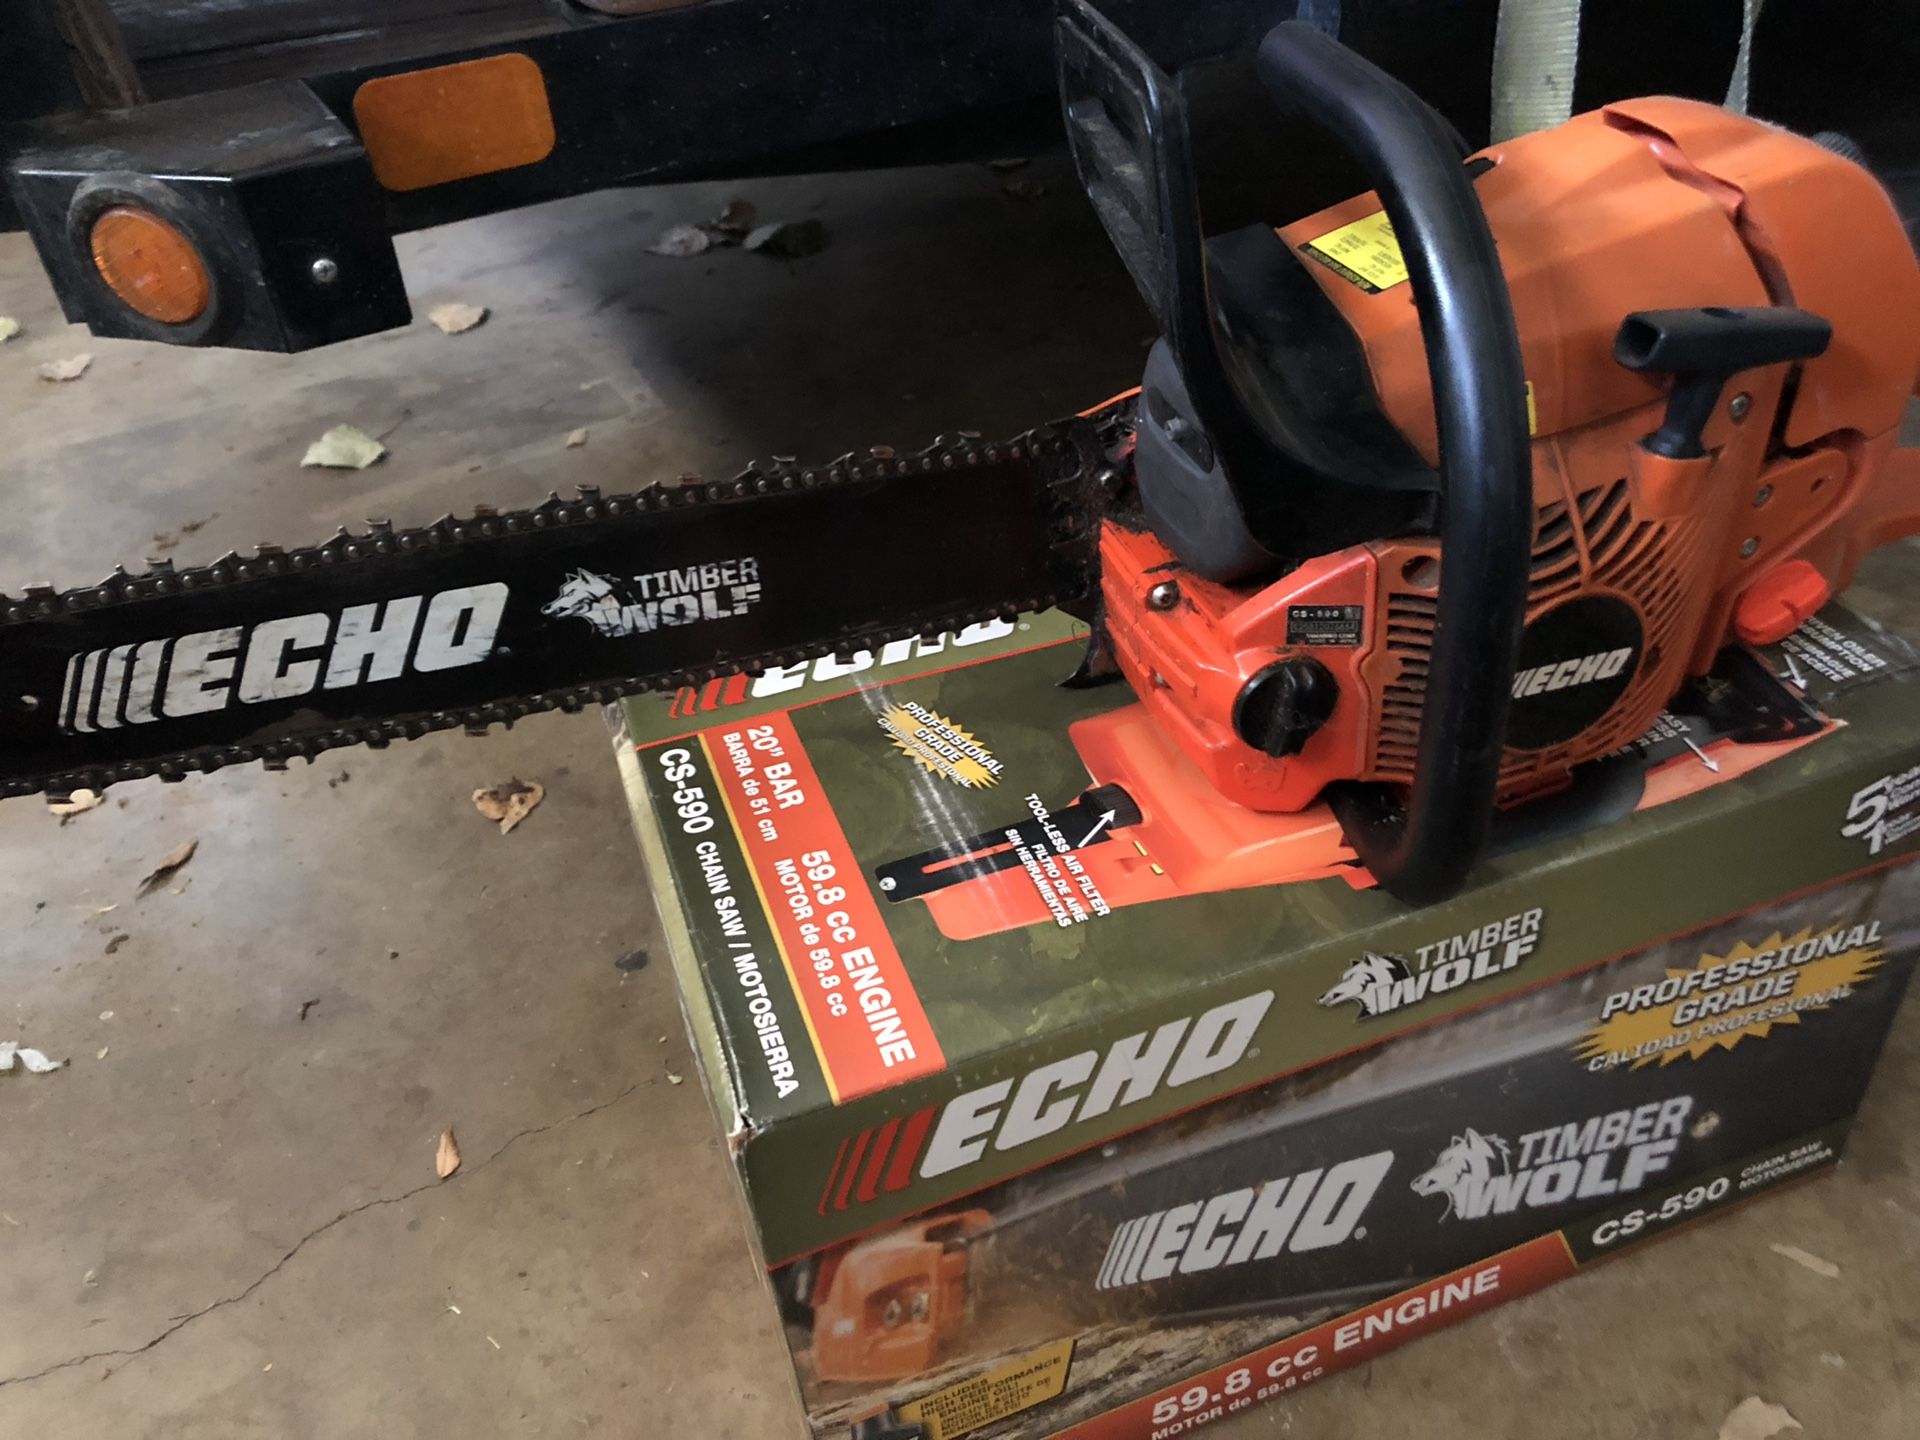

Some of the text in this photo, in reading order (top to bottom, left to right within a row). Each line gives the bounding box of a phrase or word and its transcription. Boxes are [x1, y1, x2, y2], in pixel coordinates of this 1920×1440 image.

[600, 583, 762, 638] WOLF
[634, 557, 759, 598] TIMBER
[160, 582, 509, 718] ECHO
[1524, 647, 1633, 697] ECHO
[1798, 653, 1845, 682] ACEITE
[901, 701, 1004, 775] PROFESSIONAL
[913, 743, 972, 788] PROFESIONAL
[914, 727, 964, 764] GRADE
[659, 747, 715, 834] CS-590
[763, 761, 805, 810] BAR
[1841, 775, 1894, 837] 5
[695, 841, 732, 895] CHAIN
[722, 732, 849, 1018] BARRA de 51 cm MOTOR de 59.8 cc
[801, 849, 846, 906] 59.8
[1005, 828, 1073, 928] SIN HERRAMIENTAS
[1024, 793, 1111, 917] TOOL-LESS AIR FILTER
[1031, 842, 1089, 923] FILTRO DE AIRE
[713, 896, 747, 937] SAW
[826, 910, 857, 944] cc
[1416, 907, 1543, 970] TIMBER
[841, 946, 917, 1068] ENGINE
[1376, 933, 1538, 1014] WOLF
[1600, 920, 1882, 1020] PROFESSIONAL
[1672, 970, 1798, 1027] GRADE
[733, 952, 799, 1099] MOTOSIERRA
[1587, 984, 1856, 1072] CALIDAD PROFESIONAL
[919, 990, 1276, 1179] ECHO
[1518, 1095, 1694, 1169] TIMBER
[1140, 1150, 1395, 1281] ECHO
[1464, 1138, 1679, 1219] WOLF
[1592, 1141, 1823, 1246] CS-590 CHAIN SAW
[1151, 1265, 1501, 1425] 59.8 cc ENGINE
[921, 1356, 1062, 1418] HIGH PERFORMANCE
[921, 1378, 988, 1411] INCLUDES
[938, 1393, 989, 1419] ENGINE
[1151, 1366, 1324, 1440] MOTOR de 59.8 cc
